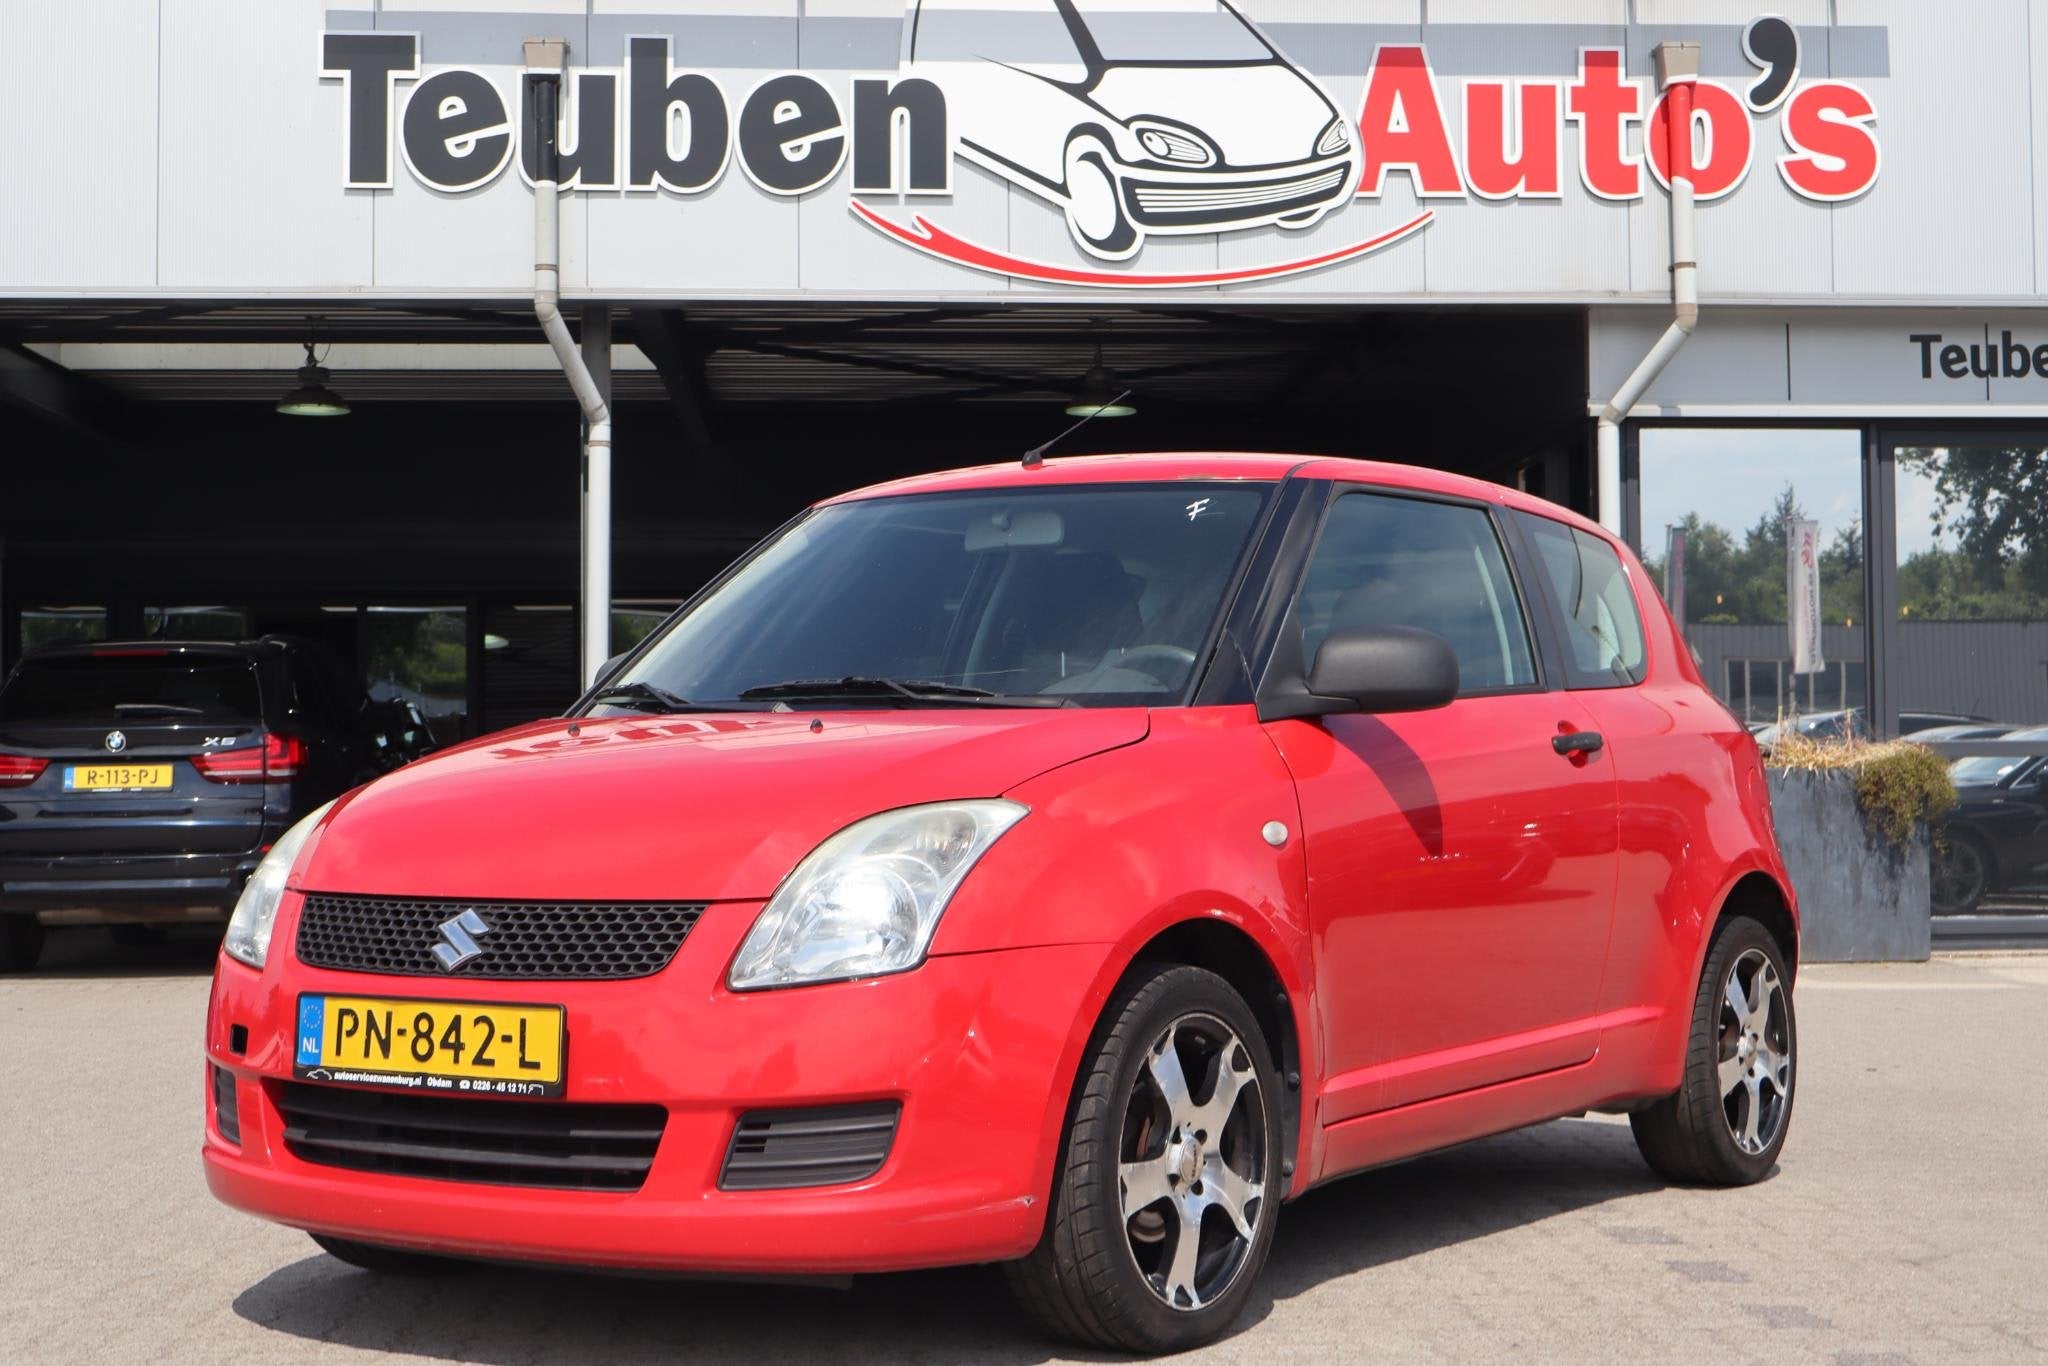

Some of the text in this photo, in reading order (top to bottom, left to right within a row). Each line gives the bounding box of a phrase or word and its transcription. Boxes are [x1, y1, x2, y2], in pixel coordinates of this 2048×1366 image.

[321, 16, 1879, 199] Teuben Auto's
[87, 768, 158, 785] R-113-PJ
[302, 1036, 320, 1053] NL
[335, 1007, 541, 1070] PN-842-L
[427, 1076, 453, 1088] Obdam
[472, 1080, 491, 1091] 0226
[507, 1083, 517, 1093] 12
[518, 1084, 527, 1094] 71
